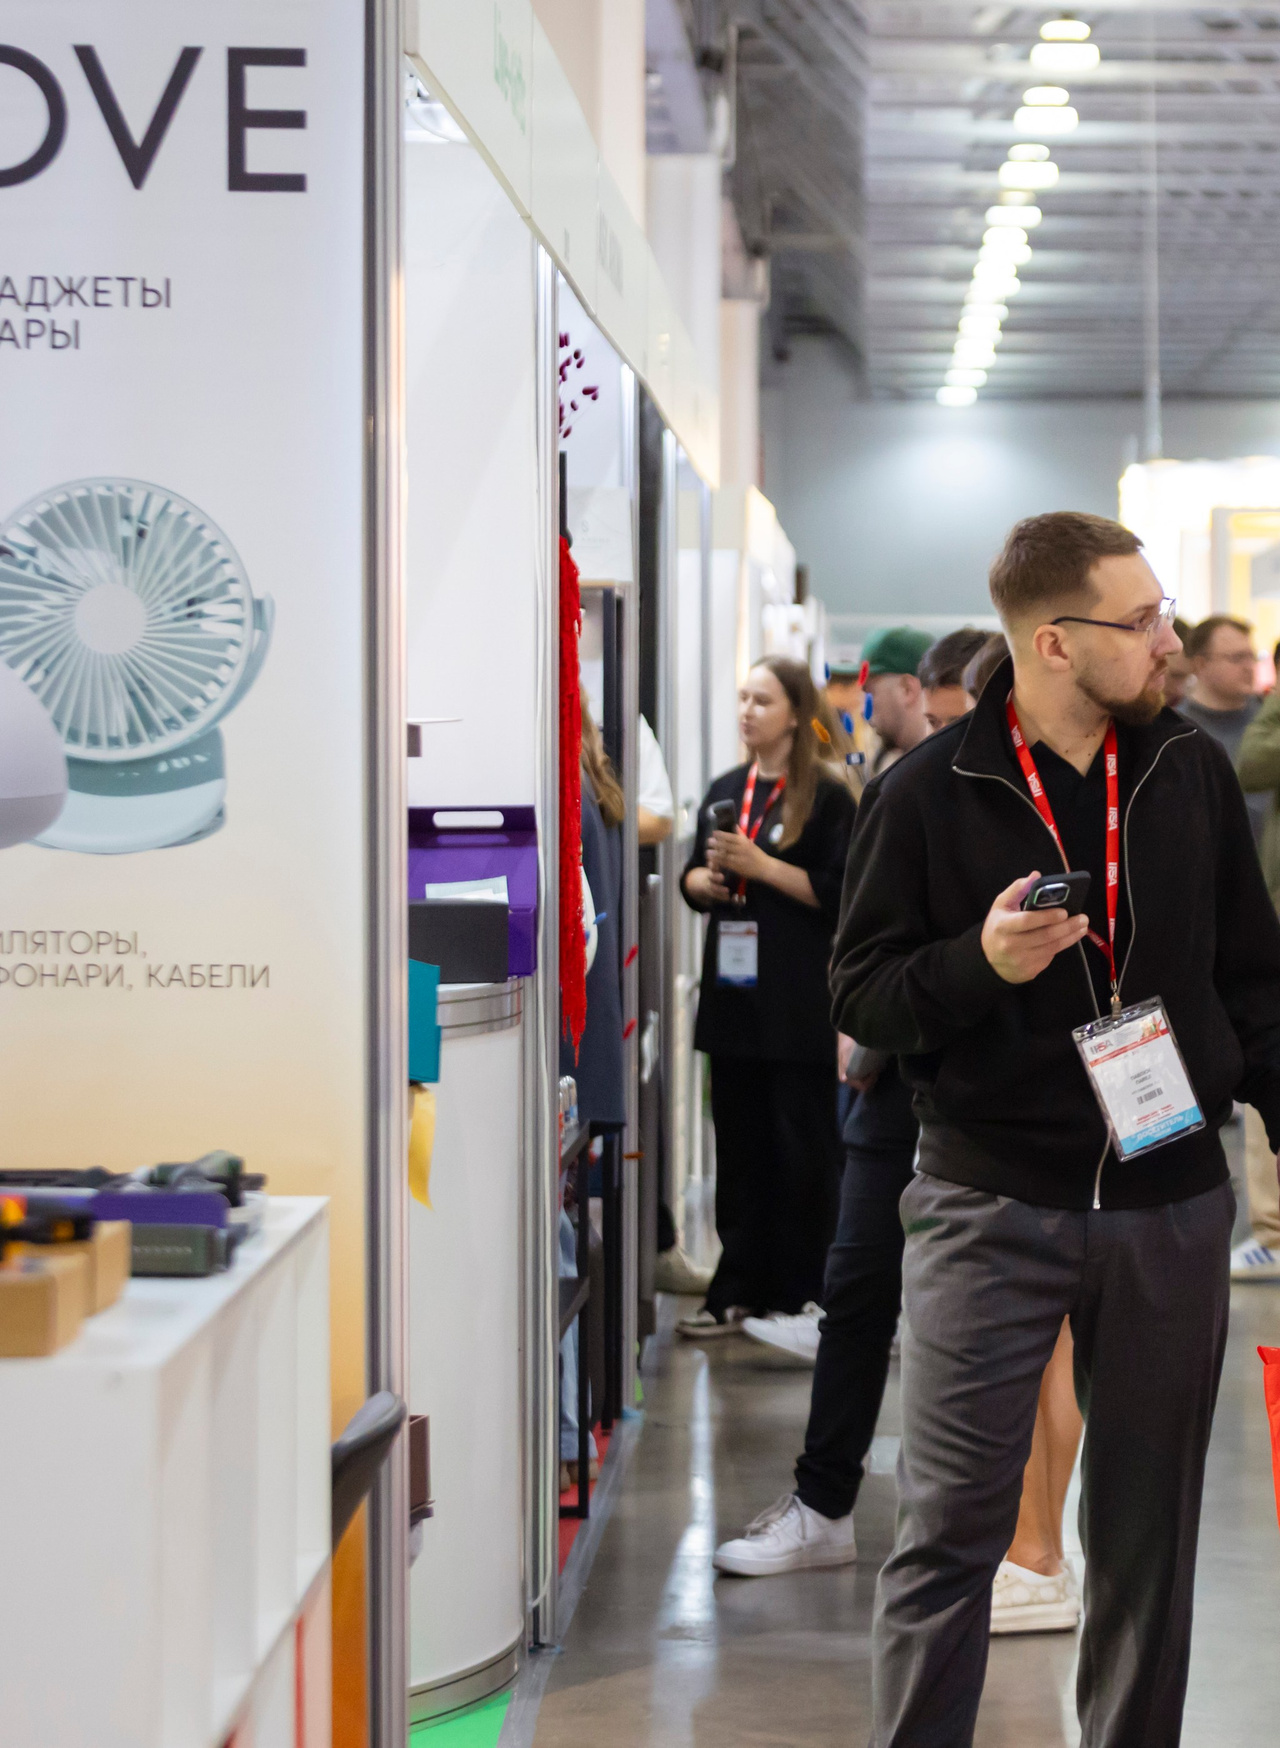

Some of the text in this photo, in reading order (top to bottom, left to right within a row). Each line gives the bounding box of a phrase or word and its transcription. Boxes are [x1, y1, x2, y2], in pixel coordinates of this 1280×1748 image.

[0, 275, 171, 312] АДЖЕТЫ
[0, 319, 80, 350] АРЫ
[0, 930, 147, 958] ЛЯТОРЫ,
[146, 963, 270, 989] КАБЕЛИ
